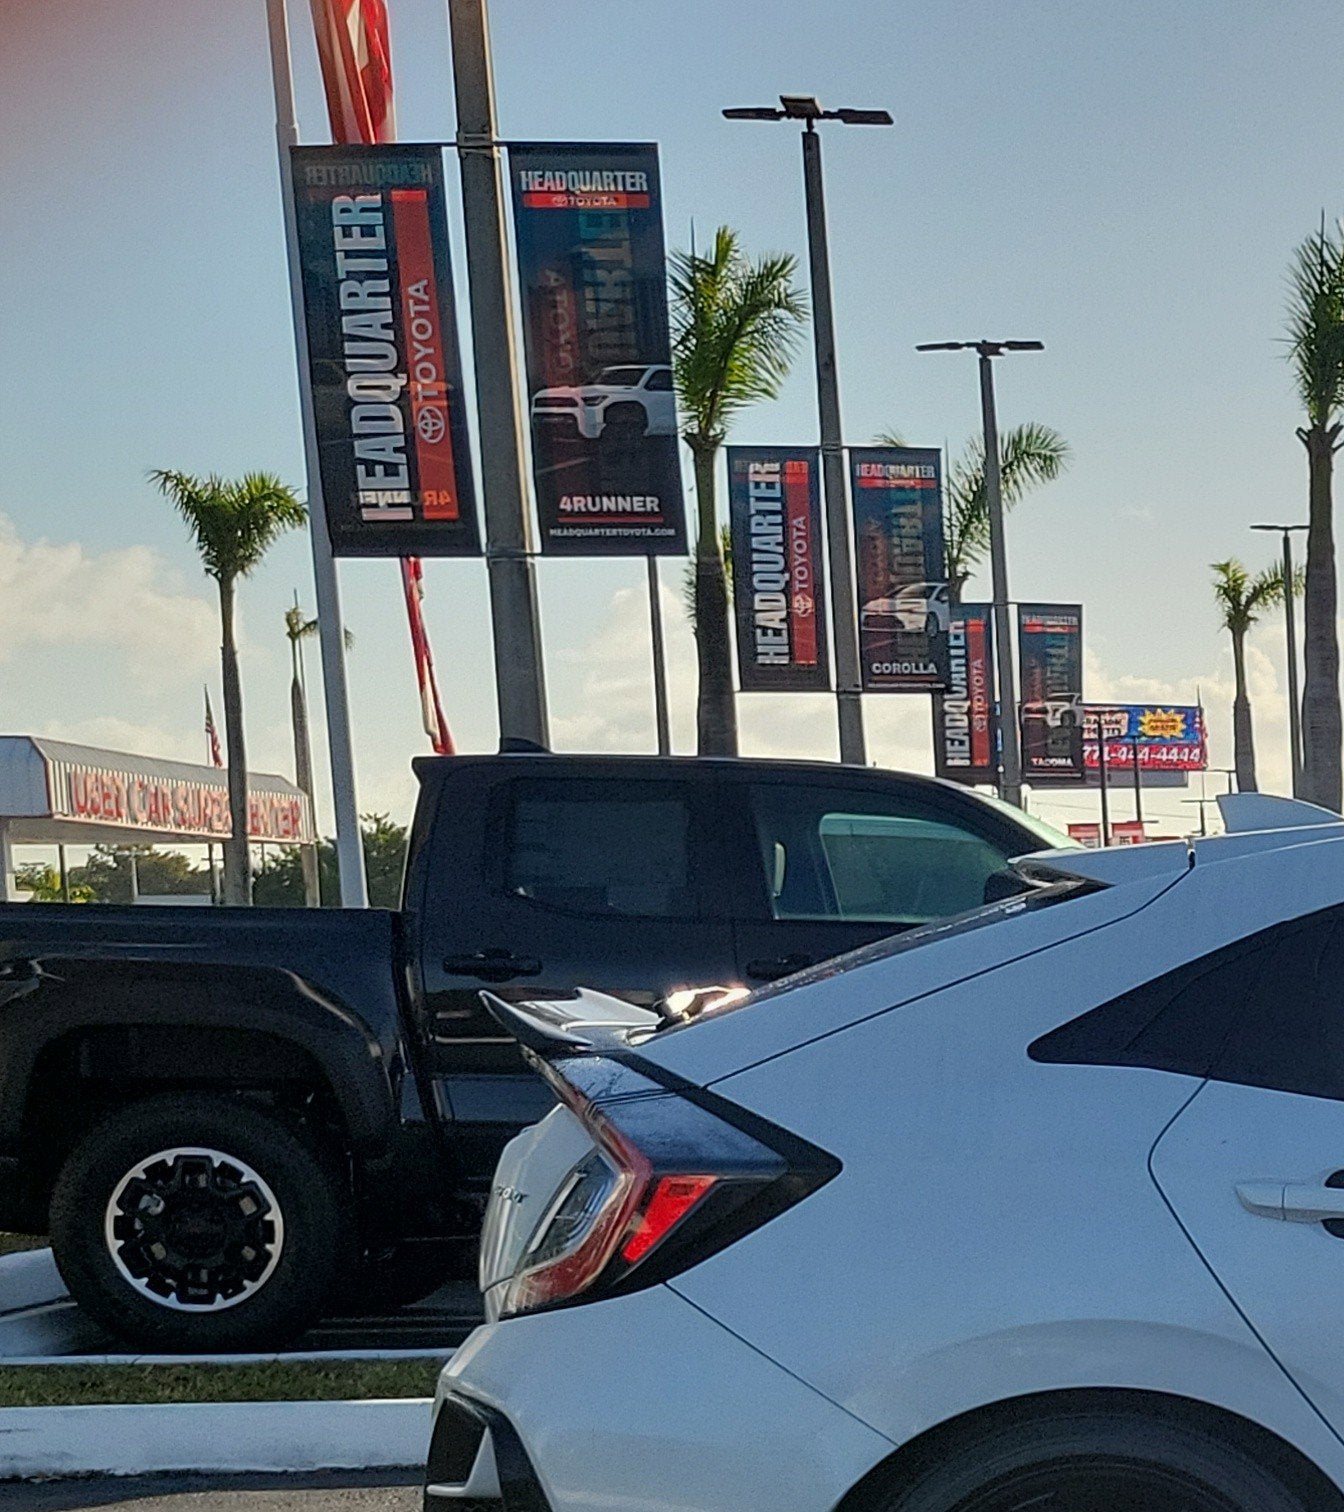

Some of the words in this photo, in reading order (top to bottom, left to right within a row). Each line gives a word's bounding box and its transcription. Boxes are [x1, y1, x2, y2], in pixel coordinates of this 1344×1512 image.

[520, 171, 648, 195] HEADQUARTER
[568, 196, 617, 207] TOYOTA
[332, 194, 415, 521] HEADQUARTER
[408, 278, 446, 400] TOYOTA
[559, 496, 660, 512] 4RUNNER
[749, 462, 789, 664] HEADQUARTER
[792, 516, 809, 594] TOYOTA
[870, 662, 938, 674] COROLLA
[943, 620, 971, 766] HEADQUARTER
